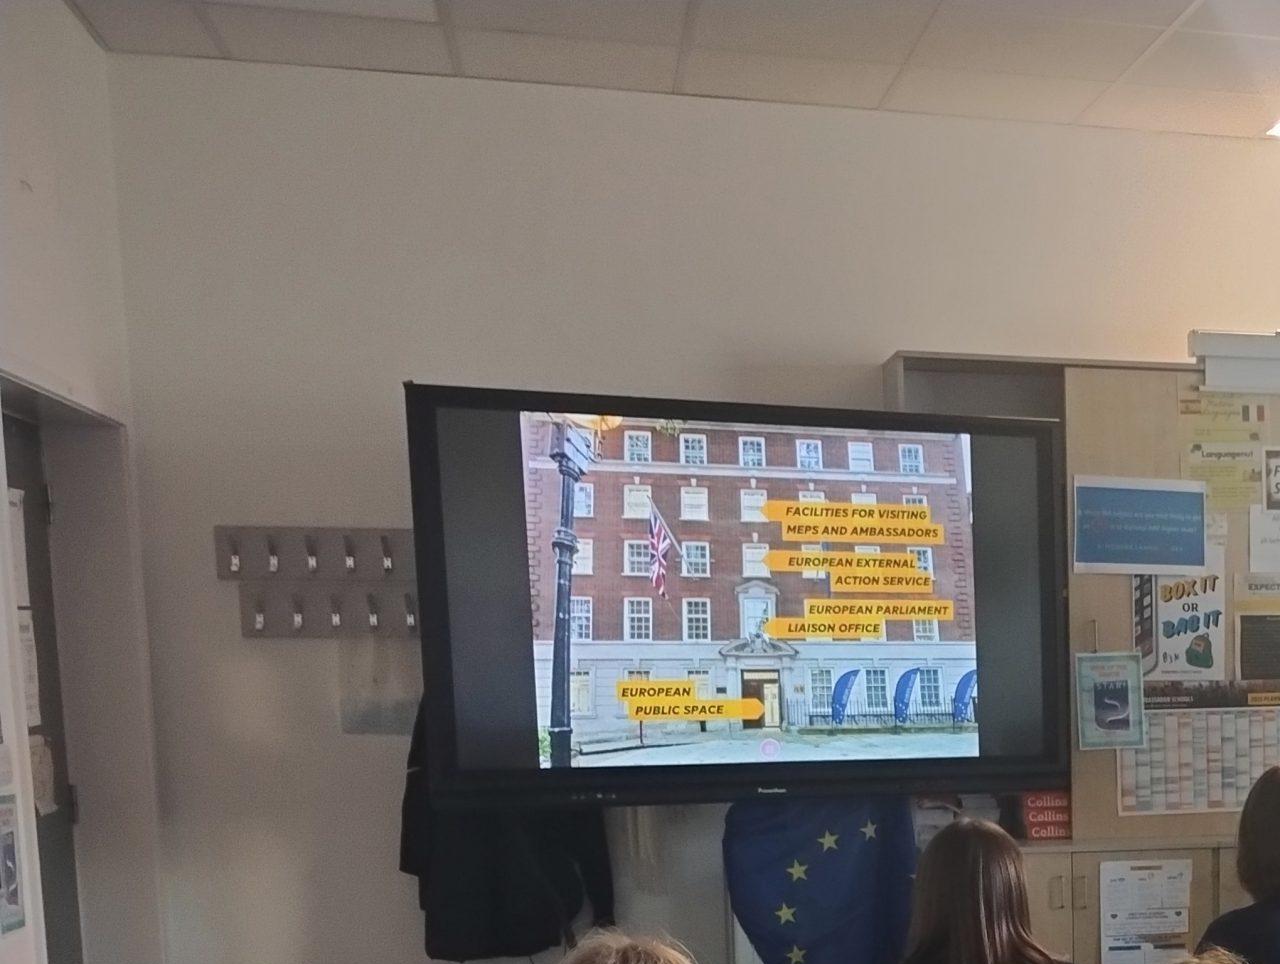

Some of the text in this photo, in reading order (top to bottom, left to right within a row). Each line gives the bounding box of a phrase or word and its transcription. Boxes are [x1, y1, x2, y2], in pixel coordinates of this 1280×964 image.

[786, 506, 928, 520] FACILITIES FOR VISITING
[786, 525, 939, 538] MEPS AND AMBASSADORS
[788, 557, 916, 569] EUROPEAN EXTERNAL
[835, 575, 931, 586] ACTION SERVICE
[1160, 575, 1219, 602] BOX IT
[809, 605, 949, 616] EUROPEAN PARLIAMENT
[1182, 602, 1199, 612] OR
[1203, 609, 1222, 629] IT
[787, 623, 881, 634] LIAISON OFFICE
[621, 687, 691, 698] EUROPEAN
[635, 705, 724, 716] PUBLIC SPACE
[1027, 796, 1068, 807] Collins
[1029, 811, 1070, 821] Collins
